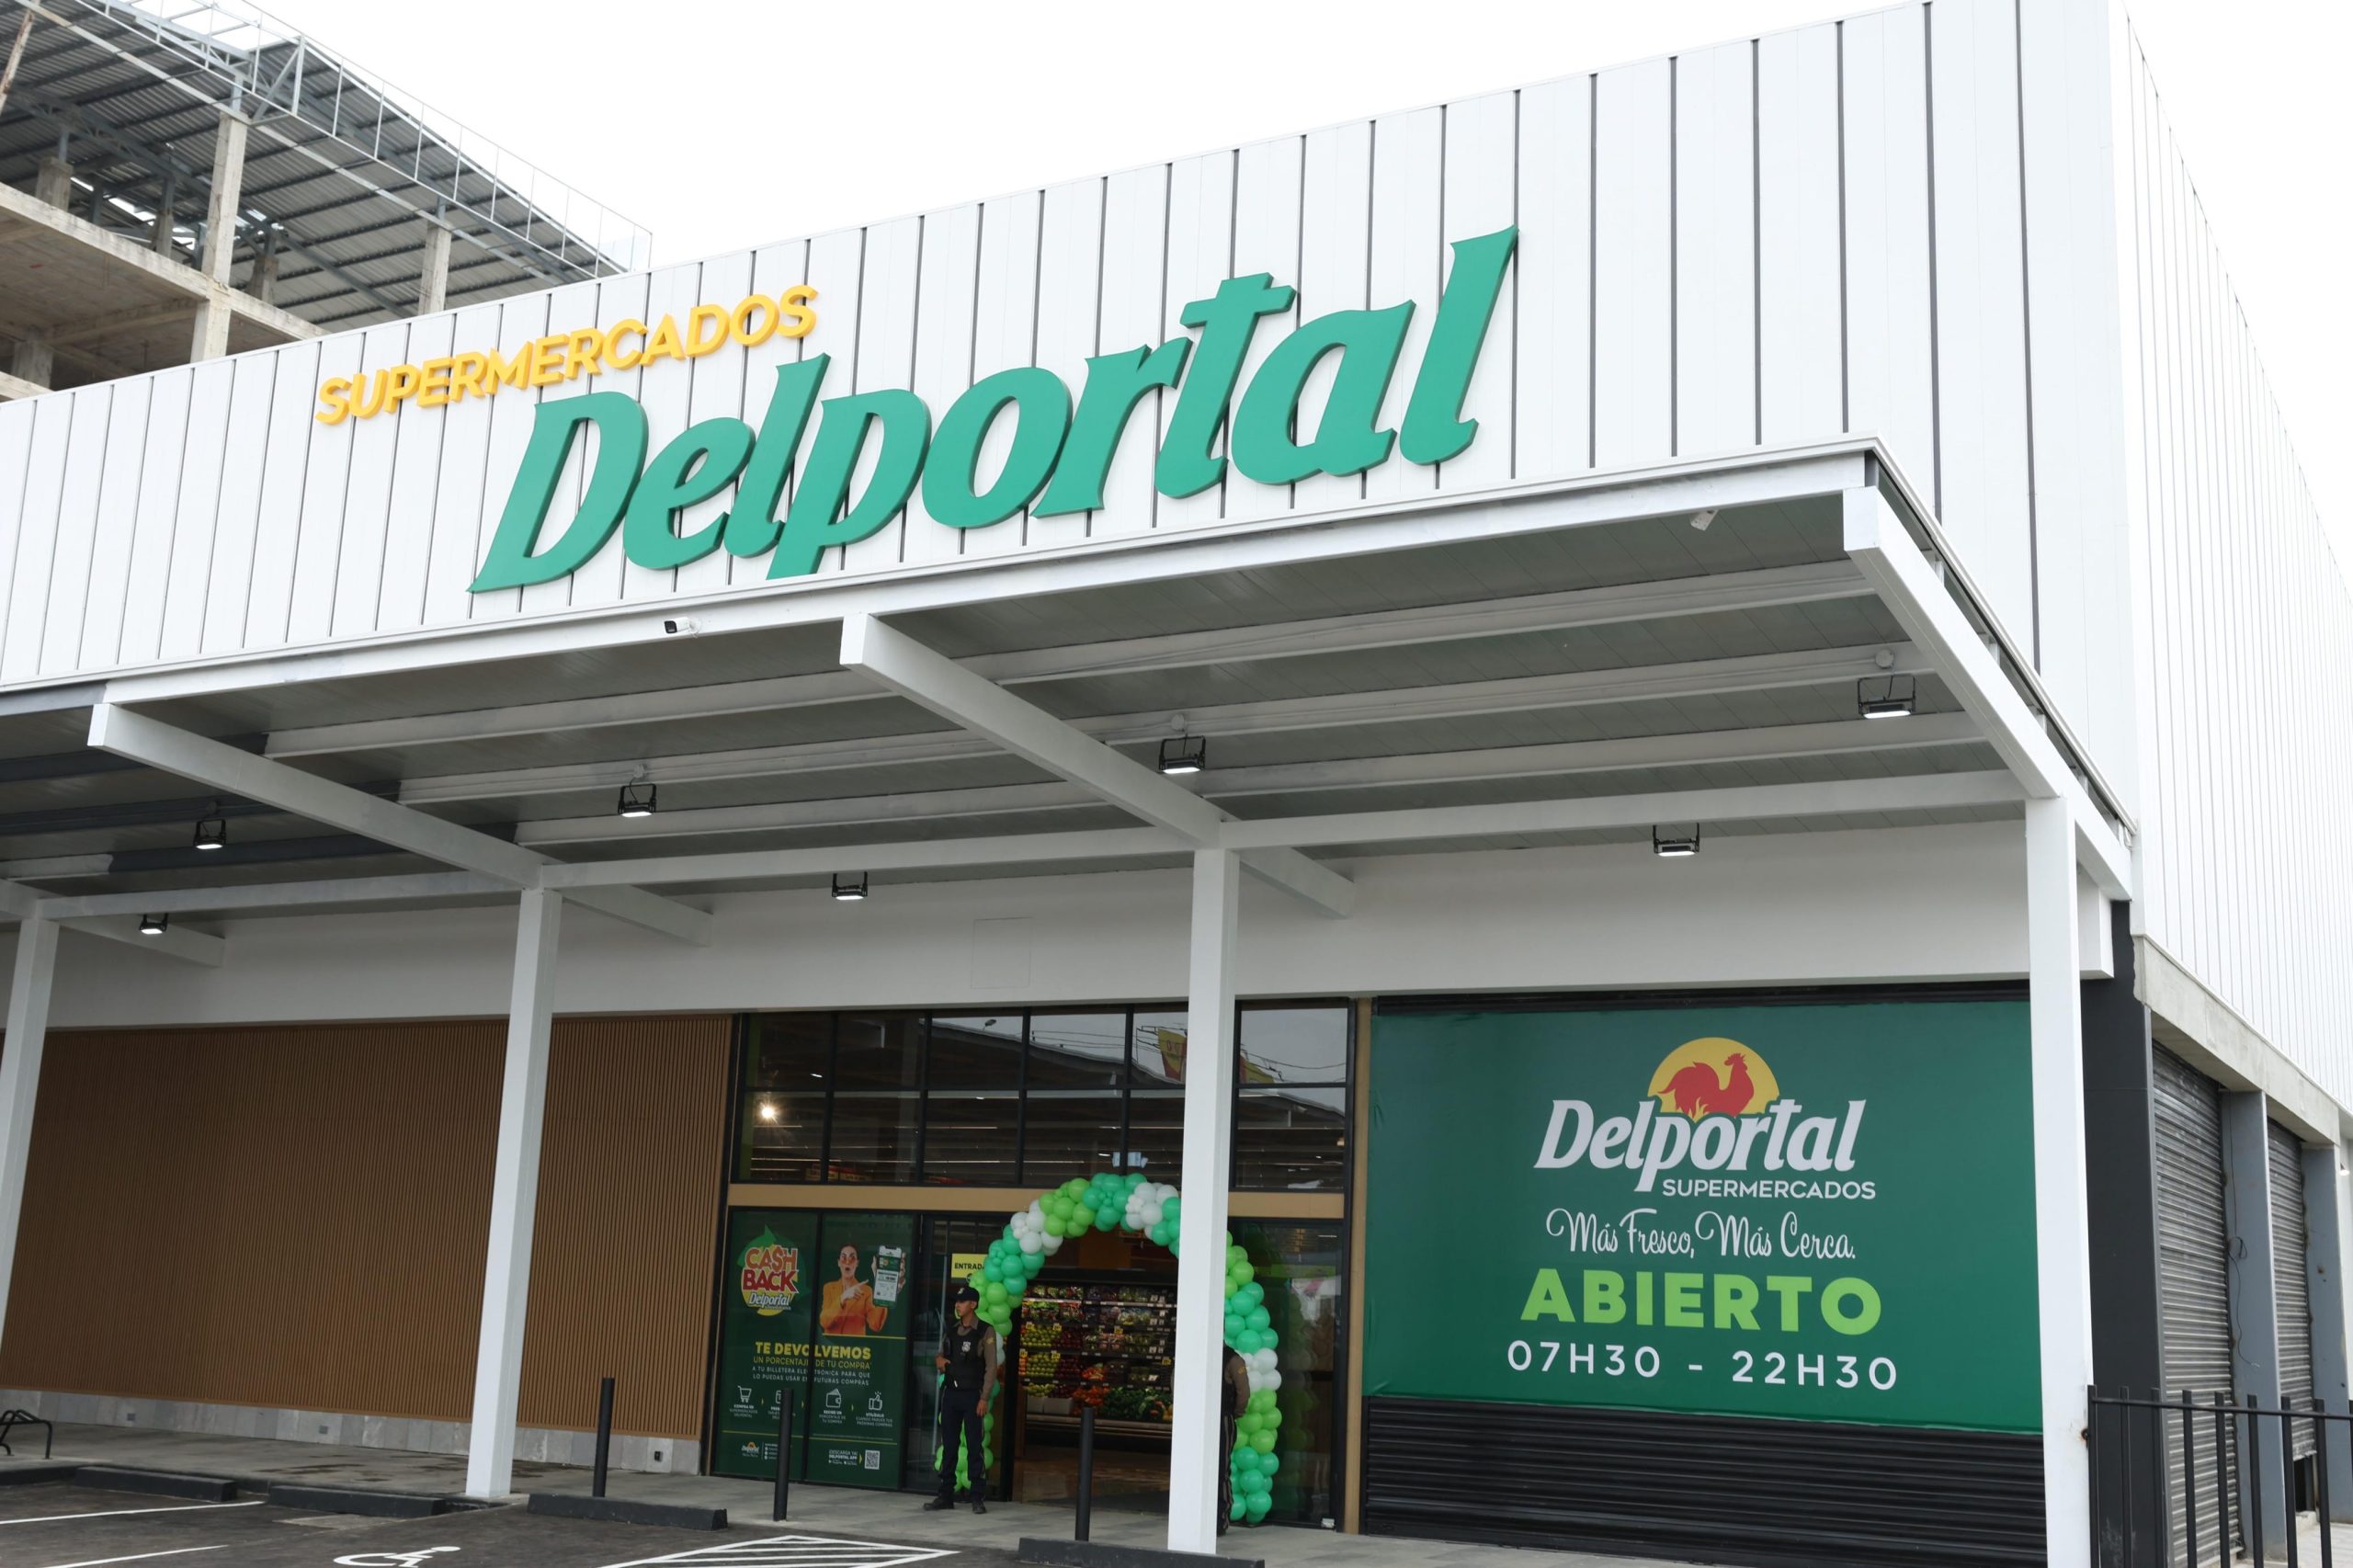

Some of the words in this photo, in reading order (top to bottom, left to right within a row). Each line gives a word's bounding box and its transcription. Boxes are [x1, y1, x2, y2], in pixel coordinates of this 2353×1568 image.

[315, 284, 819, 426] SUPERMERCADOS
[468, 225, 1520, 592] Delportal
[1533, 1099, 1867, 1192] Delportal
[1662, 1179, 1876, 1199] SUPERMERCADOS
[1546, 1208, 1618, 1255] Más
[1619, 1208, 1695, 1258] Fresco,
[1695, 1210, 1771, 1257] Más
[1780, 1211, 1856, 1259] Cerca.
[745, 1244, 799, 1273] CASH
[742, 1268, 799, 1293] BACK
[749, 1292, 790, 1308] Delportal
[1519, 1267, 1882, 1335] ABIERTO
[753, 1356, 764, 1364] UN
[766, 1357, 809, 1367] PORCENTAJ
[815, 1359, 824, 1368] DE
[755, 1342, 771, 1355] TE
[1507, 1340, 1660, 1378] 07H30
[1732, 1350, 1897, 1390] 22H30
